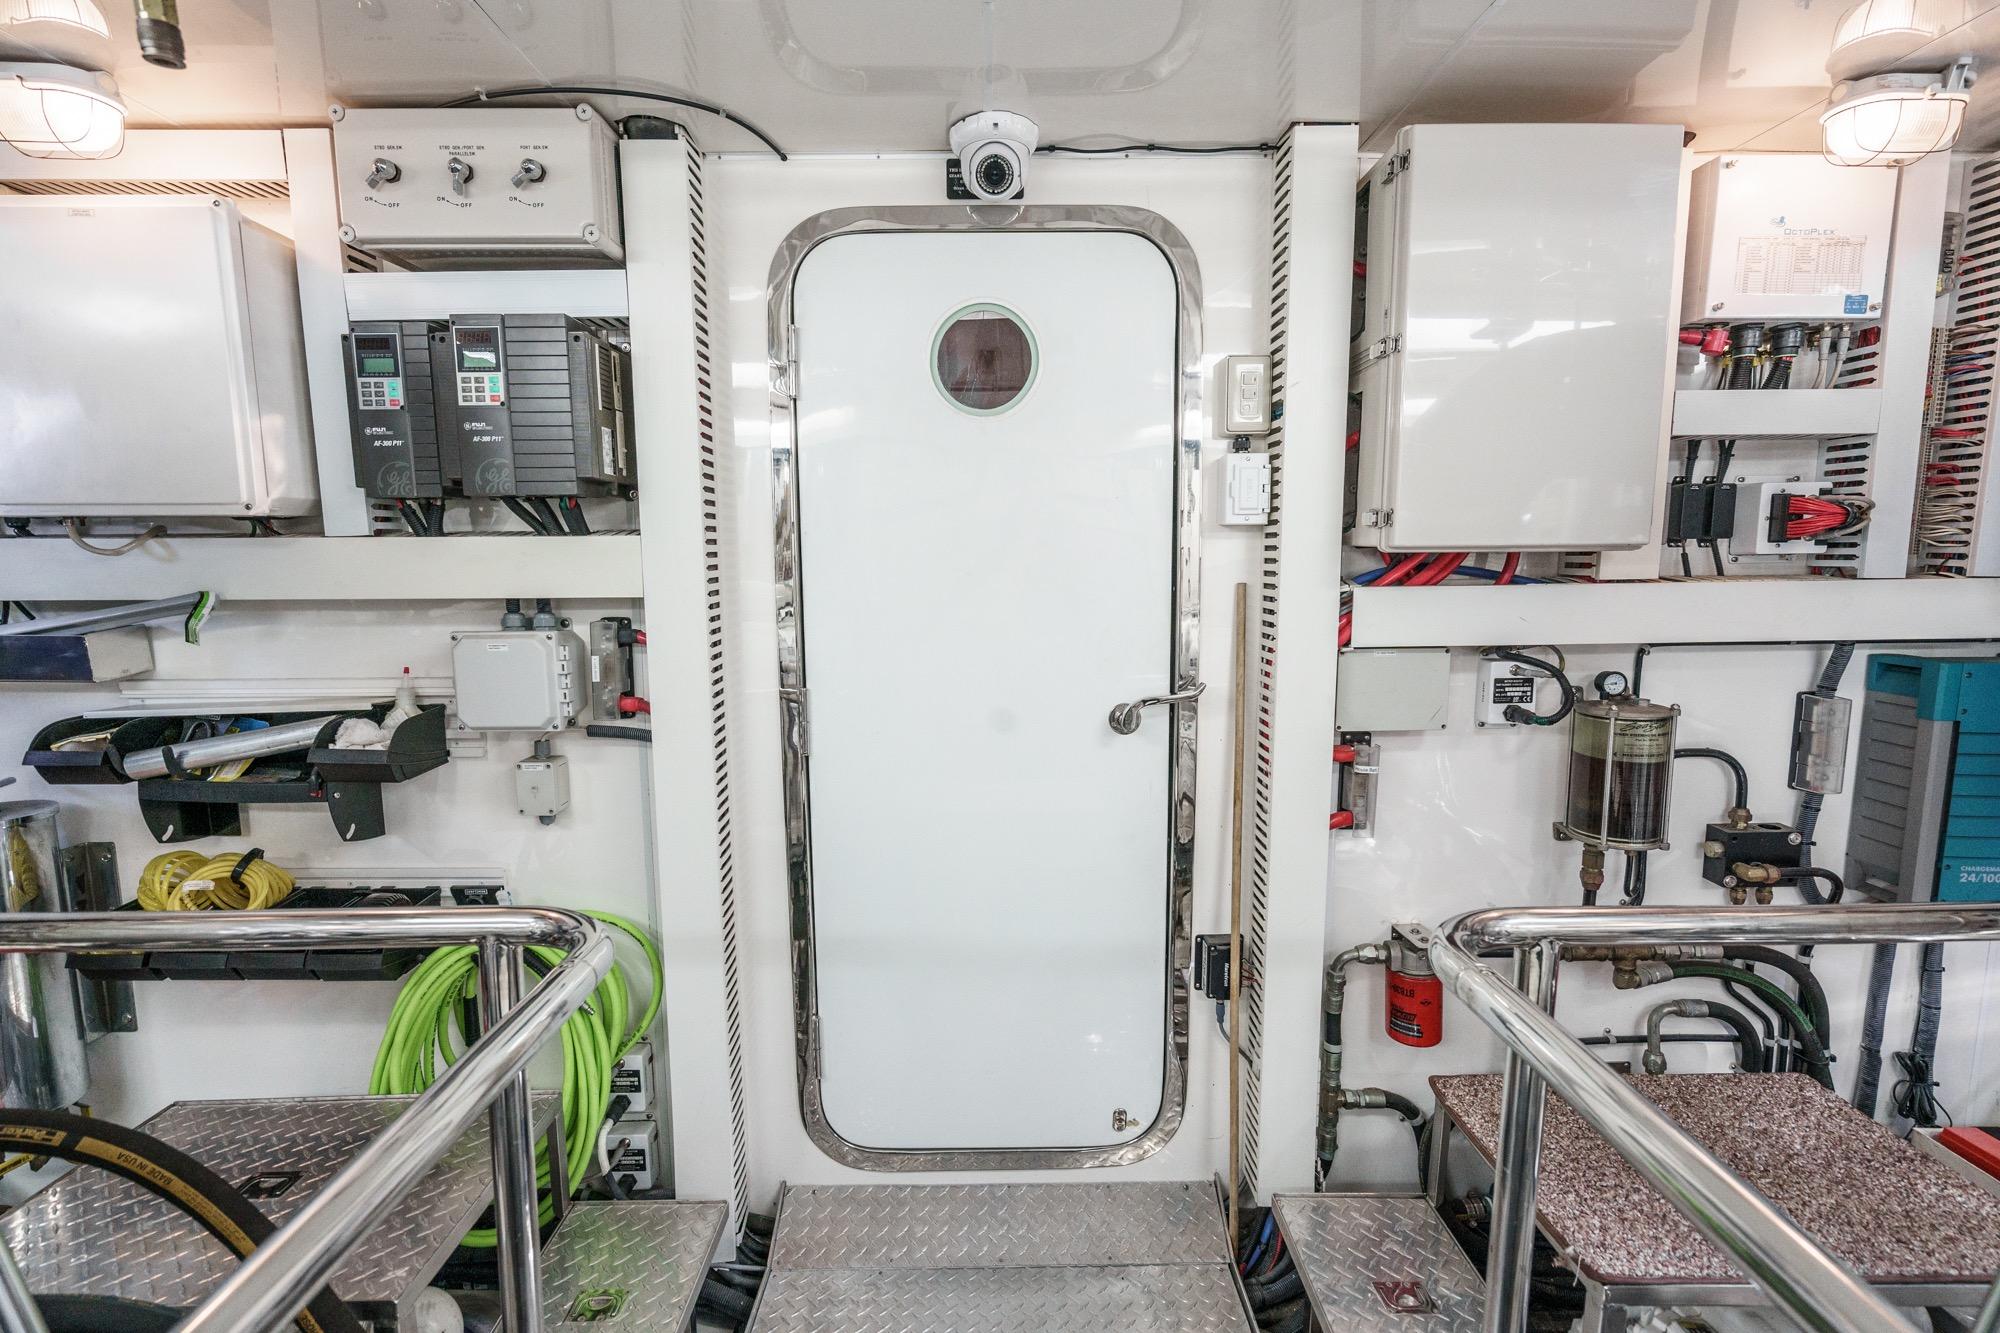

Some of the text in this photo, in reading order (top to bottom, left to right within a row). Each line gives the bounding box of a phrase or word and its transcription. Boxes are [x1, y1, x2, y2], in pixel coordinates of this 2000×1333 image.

[116, 1152, 173, 1186] MADE IN USA
